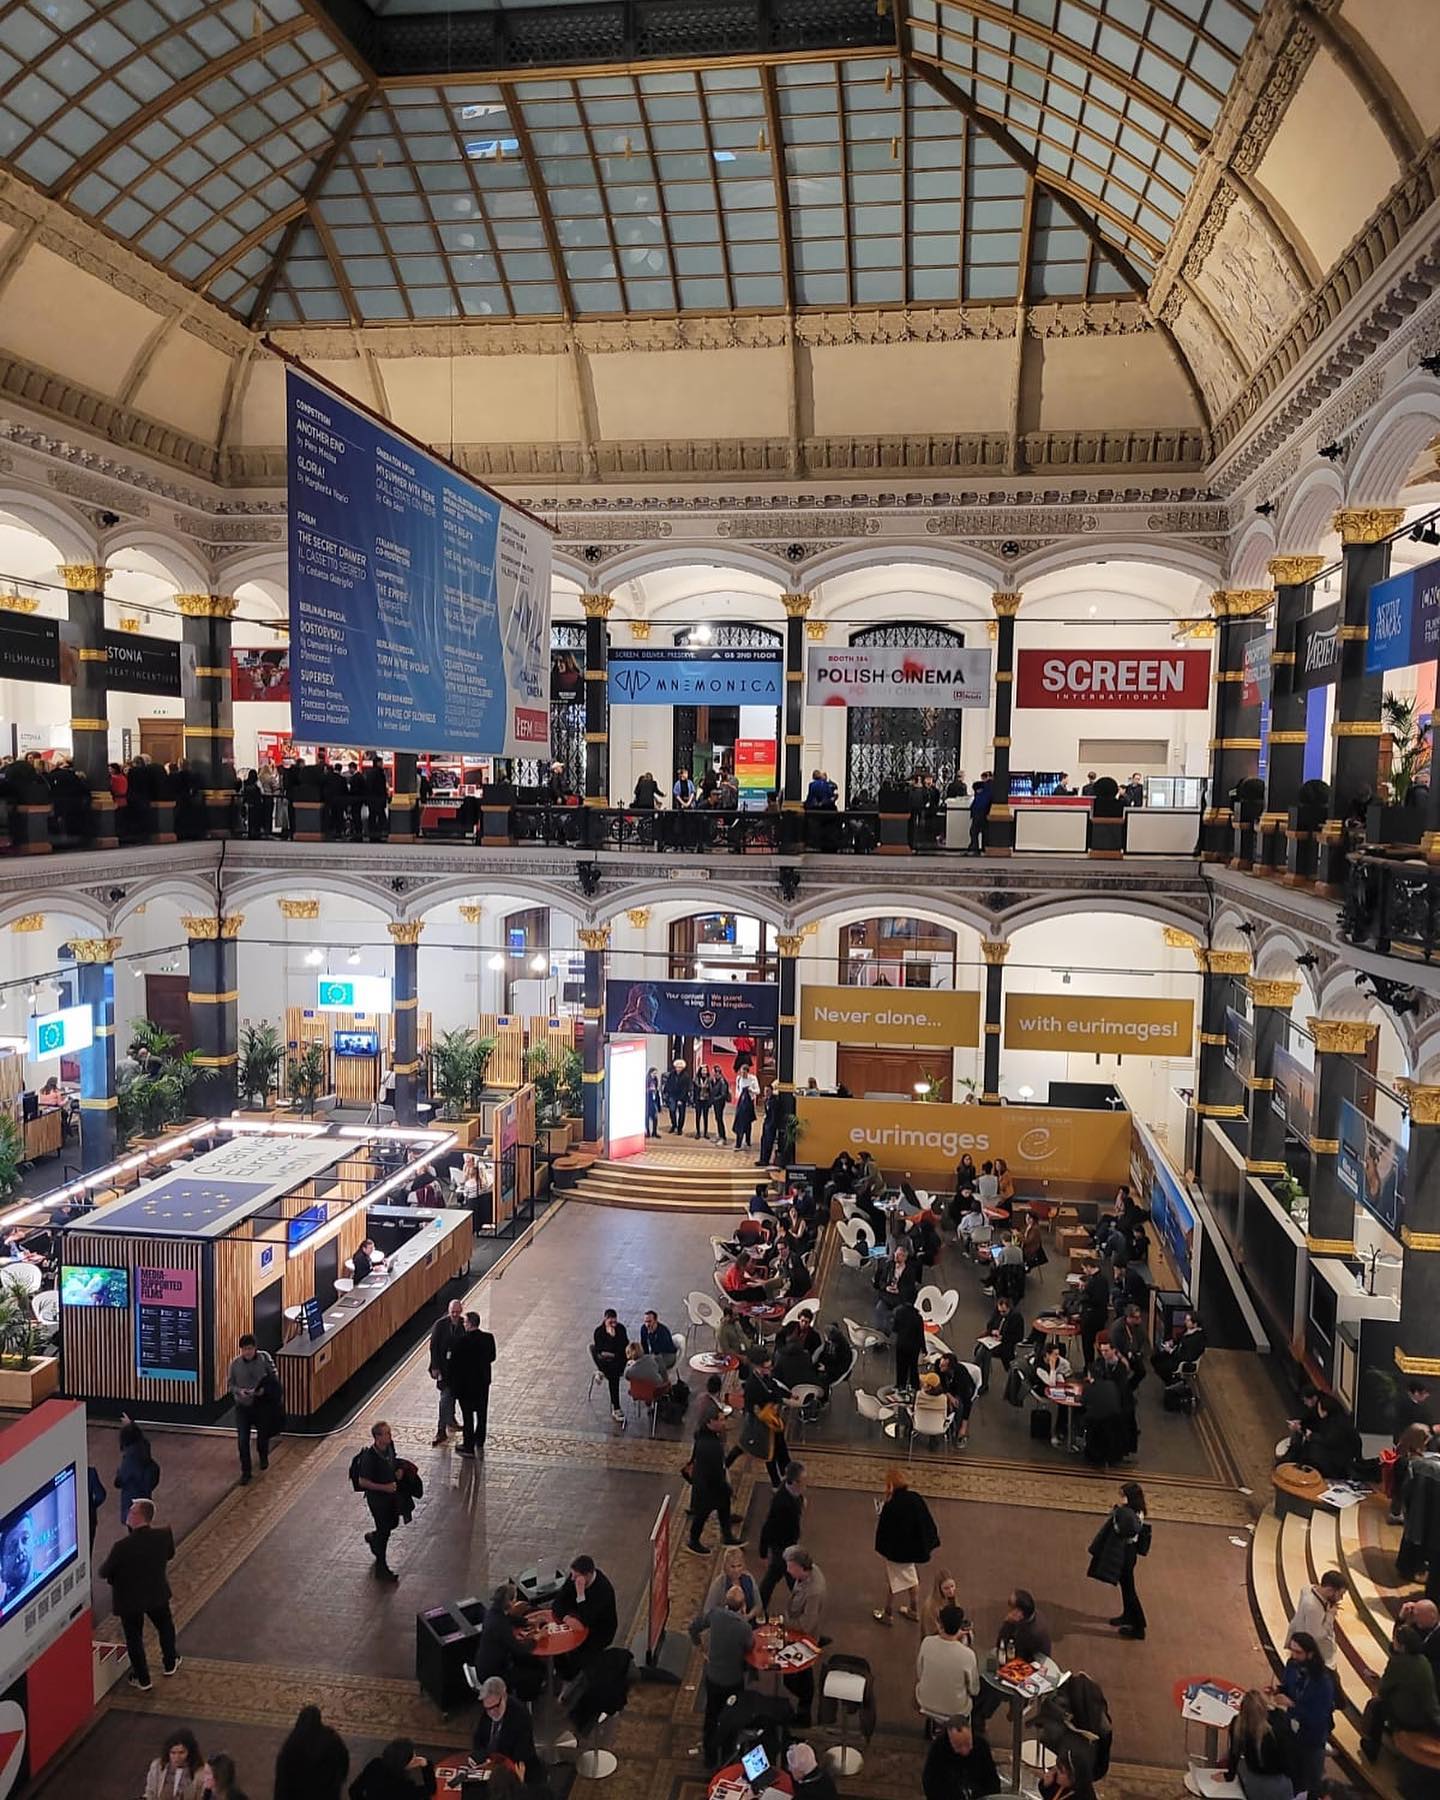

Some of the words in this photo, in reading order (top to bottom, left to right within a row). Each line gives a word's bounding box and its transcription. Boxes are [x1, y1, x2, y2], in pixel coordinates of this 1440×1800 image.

[296, 419, 330, 446] ANOTHER
[330, 437, 345, 453] END
[297, 455, 325, 479] GLORIA!
[384, 469, 408, 489] SUMMER
[298, 530, 312, 545] THE
[313, 536, 337, 555] SECRET
[339, 546, 367, 566] DRAWER
[298, 545, 304, 558] IL
[305, 548, 338, 570] CASSETTO
[4, 653, 55, 669] FILMMAKERS
[105, 666, 129, 677] REAT
[300, 669, 335, 686] SUPERSEX
[817, 668, 885, 684] POLISH
[891, 668, 965, 684] CINEMA
[1042, 659, 1185, 692] SCREEN
[656, 679, 776, 692] MNEMONICA
[377, 705, 384, 718] IN
[384, 706, 403, 719] PRAISE
[403, 709, 412, 720] OF
[521, 719, 533, 737] EFM
[665, 991, 680, 1000] Your
[680, 992, 704, 1000] content
[691, 999, 704, 1008] king
[711, 992, 722, 1000] We
[722, 994, 743, 1002] guard
[814, 1006, 872, 1025] Never
[875, 1009, 942, 1029] alone...
[1018, 1016, 1062, 1033] with
[1066, 1017, 1179, 1042] eurimages!
[849, 1124, 990, 1155] eurimages
[193, 1137, 276, 1175] Creative
[224, 1144, 299, 1177] Europe
[140, 1278, 182, 1291] SUPPORTED
[140, 1288, 164, 1300] FILMS
